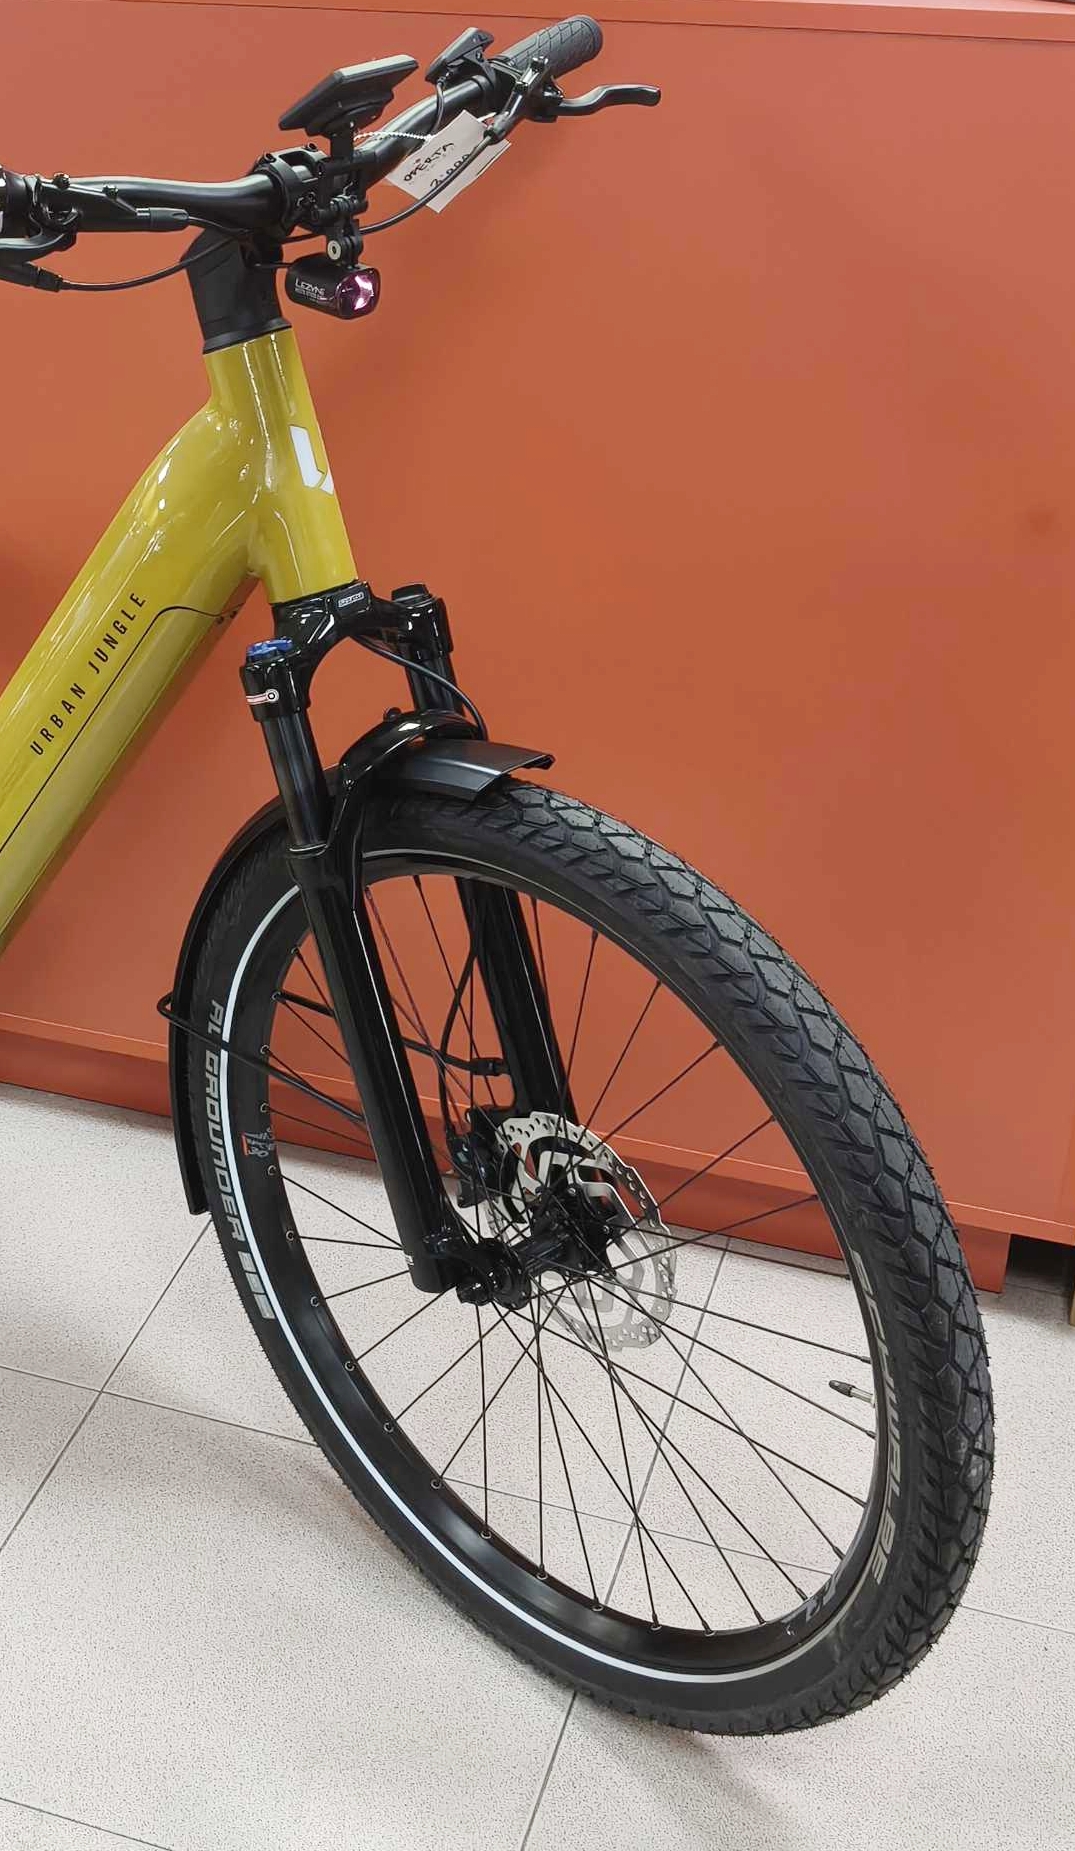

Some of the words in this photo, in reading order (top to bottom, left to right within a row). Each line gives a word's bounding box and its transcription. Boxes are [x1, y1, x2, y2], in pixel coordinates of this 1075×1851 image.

[29, 682, 87, 757] URBAN
[87, 592, 147, 675] JUNGLE
[206, 999, 224, 1035] AL
[204, 1049, 246, 1243] GROUNDER
